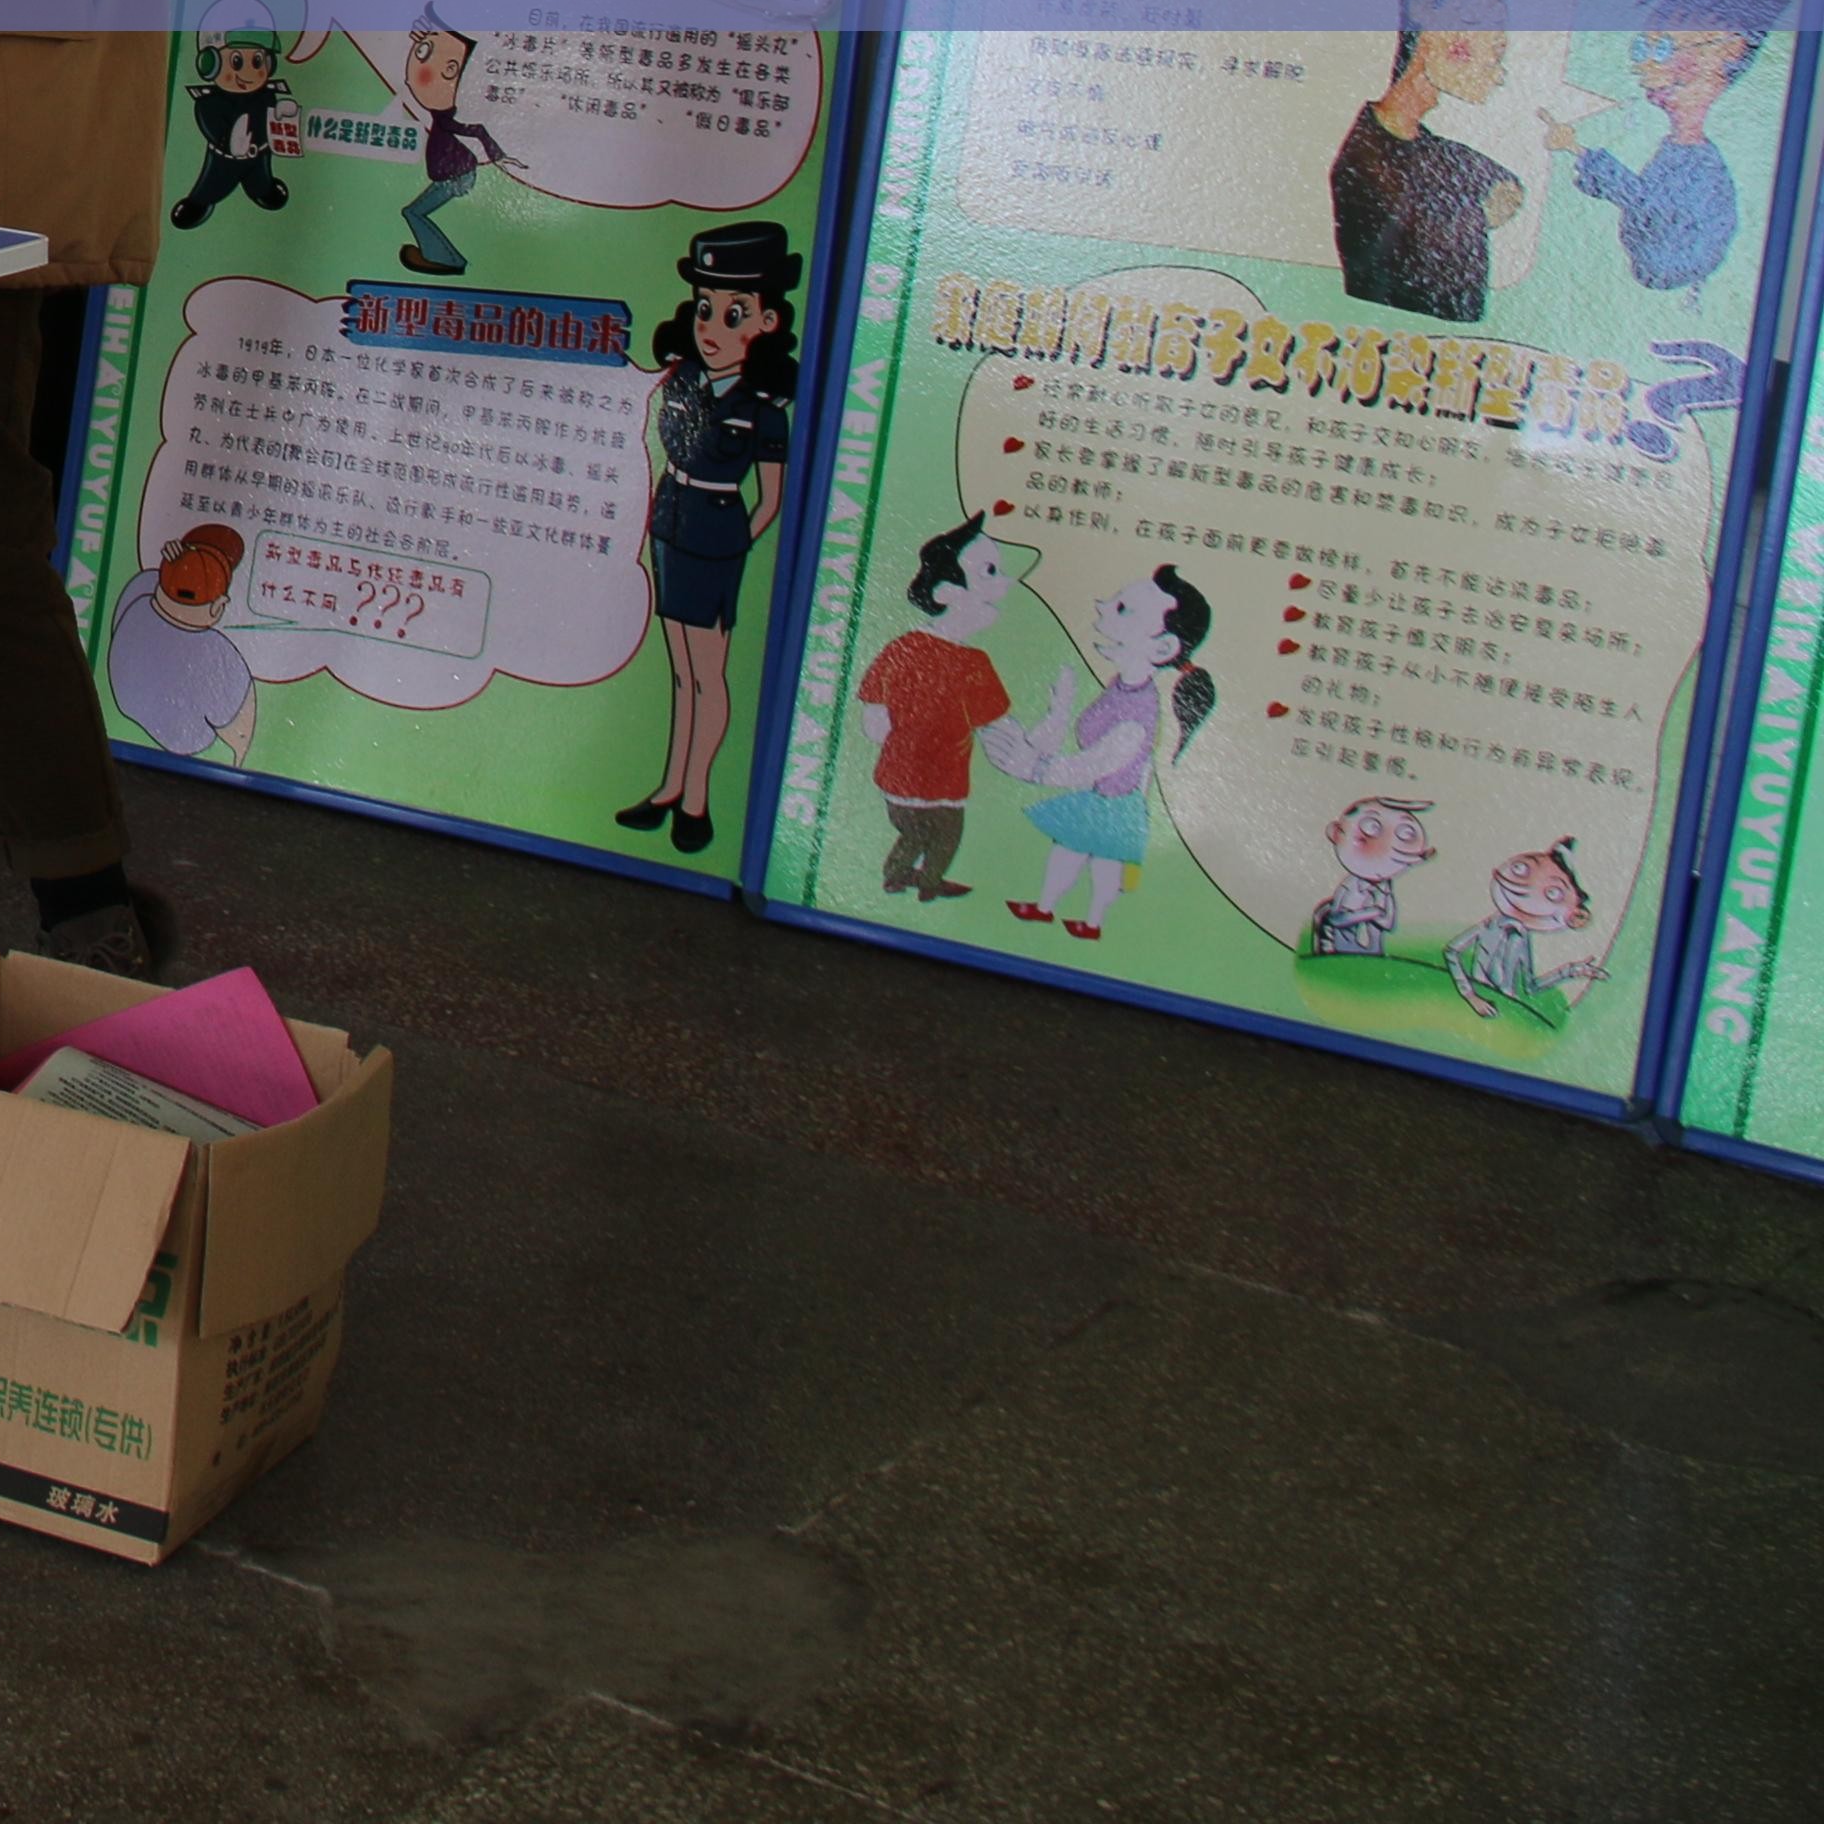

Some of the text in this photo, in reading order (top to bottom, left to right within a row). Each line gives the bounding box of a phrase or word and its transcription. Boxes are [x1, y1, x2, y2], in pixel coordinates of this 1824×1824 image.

[354, 291, 629, 356] 新型毒品的由来
[261, 581, 338, 612] 什么不同
[46, 1484, 120, 1525] 玻璃水
